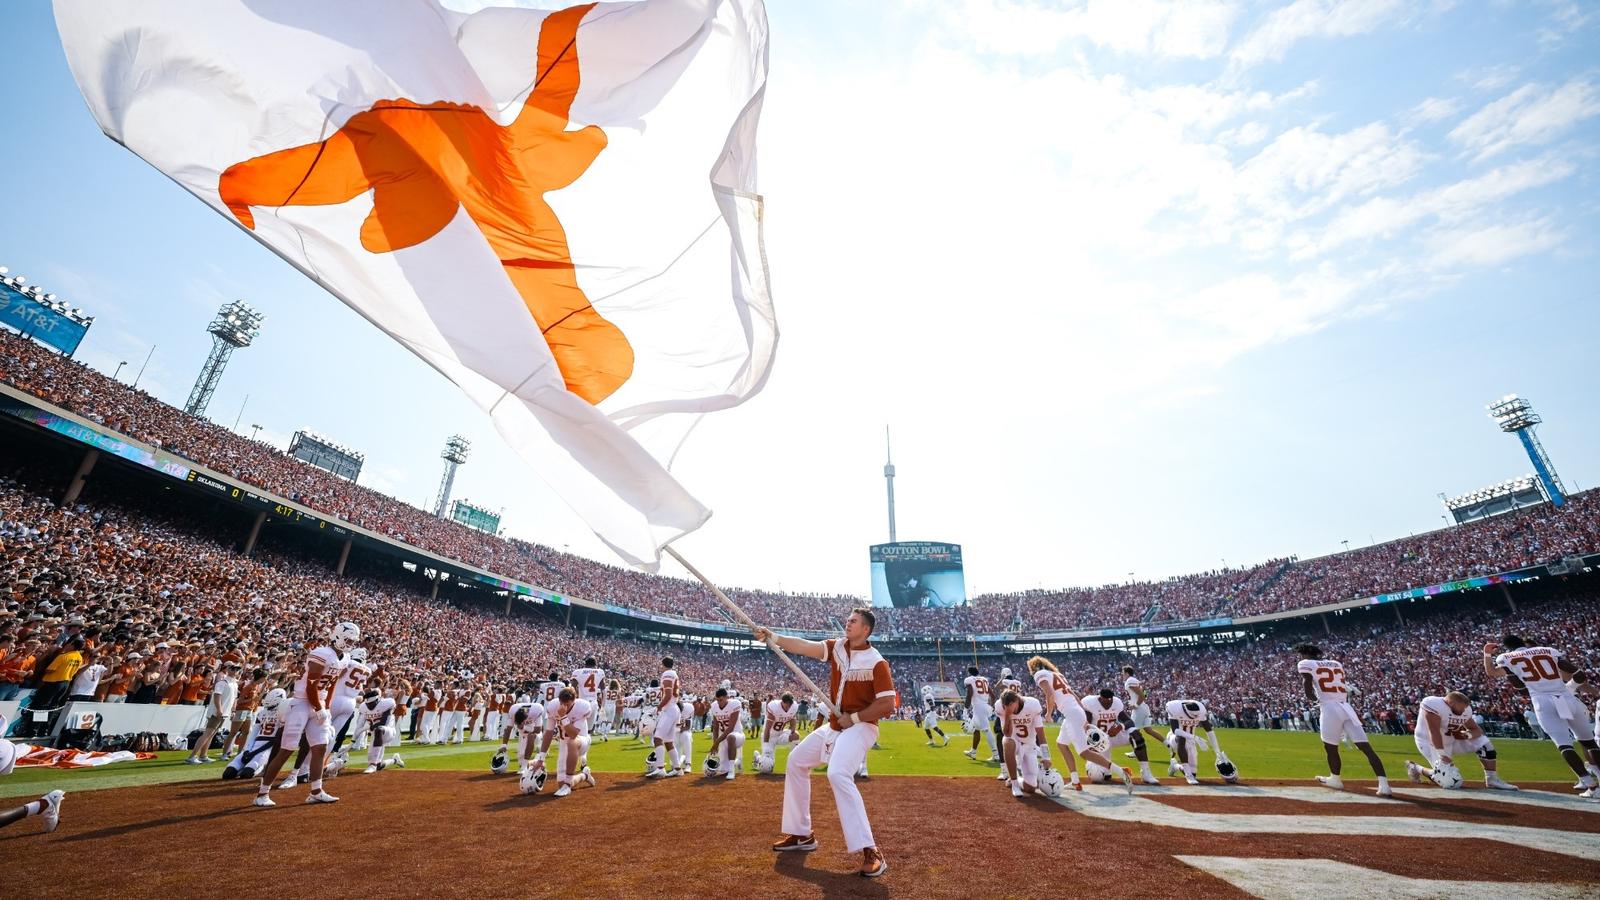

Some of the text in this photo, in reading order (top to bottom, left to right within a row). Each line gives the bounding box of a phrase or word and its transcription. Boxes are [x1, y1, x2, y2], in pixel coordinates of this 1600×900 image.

[11, 304, 59, 332] AT&T
[68, 427, 99, 445] AT&T
[197, 476, 227, 492] OKLAHOMA
[231, 488, 240, 498] 0
[275, 505, 293, 517] 4:17
[319, 521, 326, 529] 0
[882, 546, 949, 555] COTTON BOWL
[1387, 593, 1402, 601] AT&T
[1510, 655, 1560, 682] 30
[584, 674, 596, 692] 4
[975, 680, 989, 694] 90
[1316, 668, 1347, 692] 23
[546, 687, 555, 701] 8
[606, 690, 618, 700] 32
[650, 691, 663, 702] 24
[1016, 725, 1028, 738] 3
